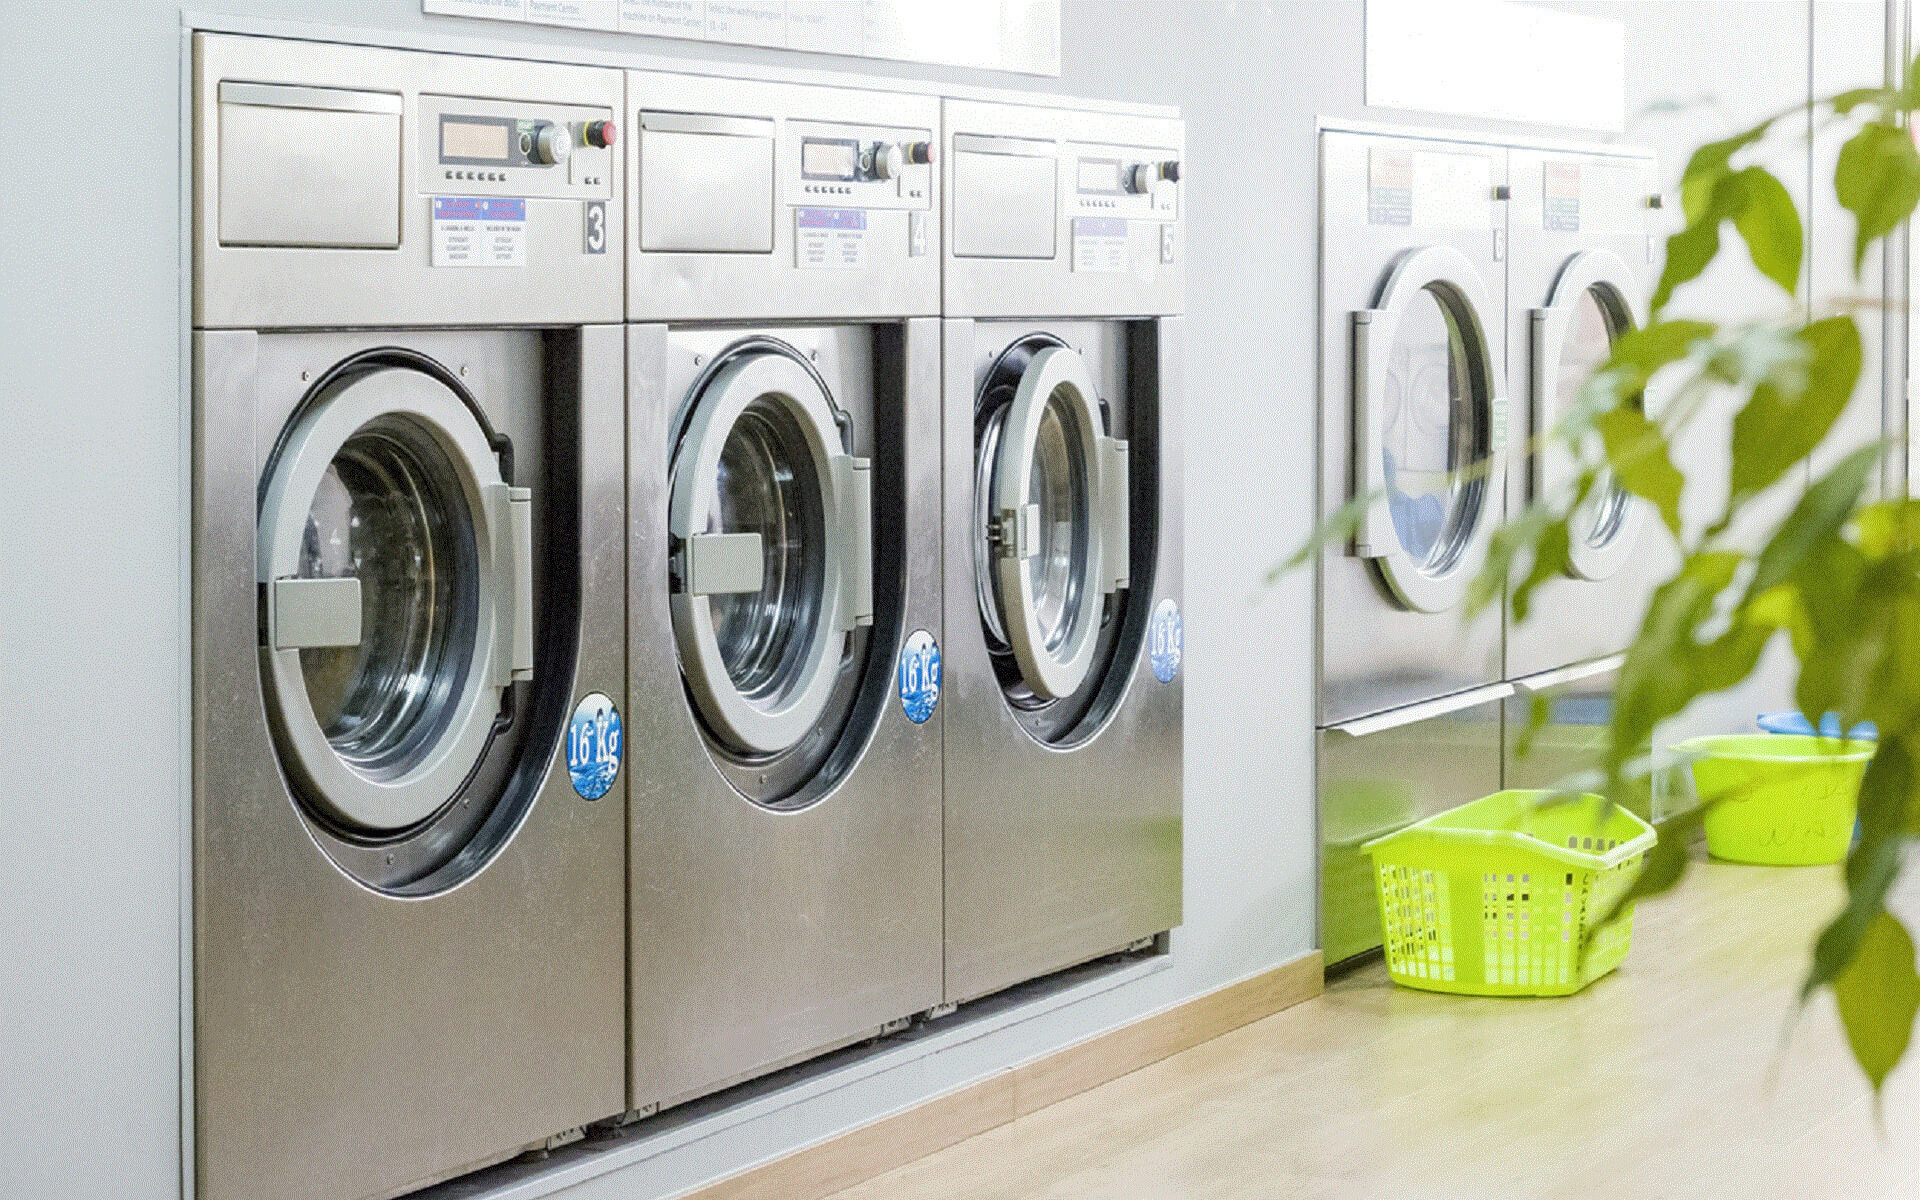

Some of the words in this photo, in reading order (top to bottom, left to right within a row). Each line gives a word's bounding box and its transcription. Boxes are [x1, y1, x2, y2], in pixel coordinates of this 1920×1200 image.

[588, 205, 604, 251] 3
[913, 214, 926, 254] 4
[901, 656, 920, 695] 16
[921, 650, 939, 702] Kg
[569, 722, 594, 767] 16
[595, 718, 620, 776] Kg
